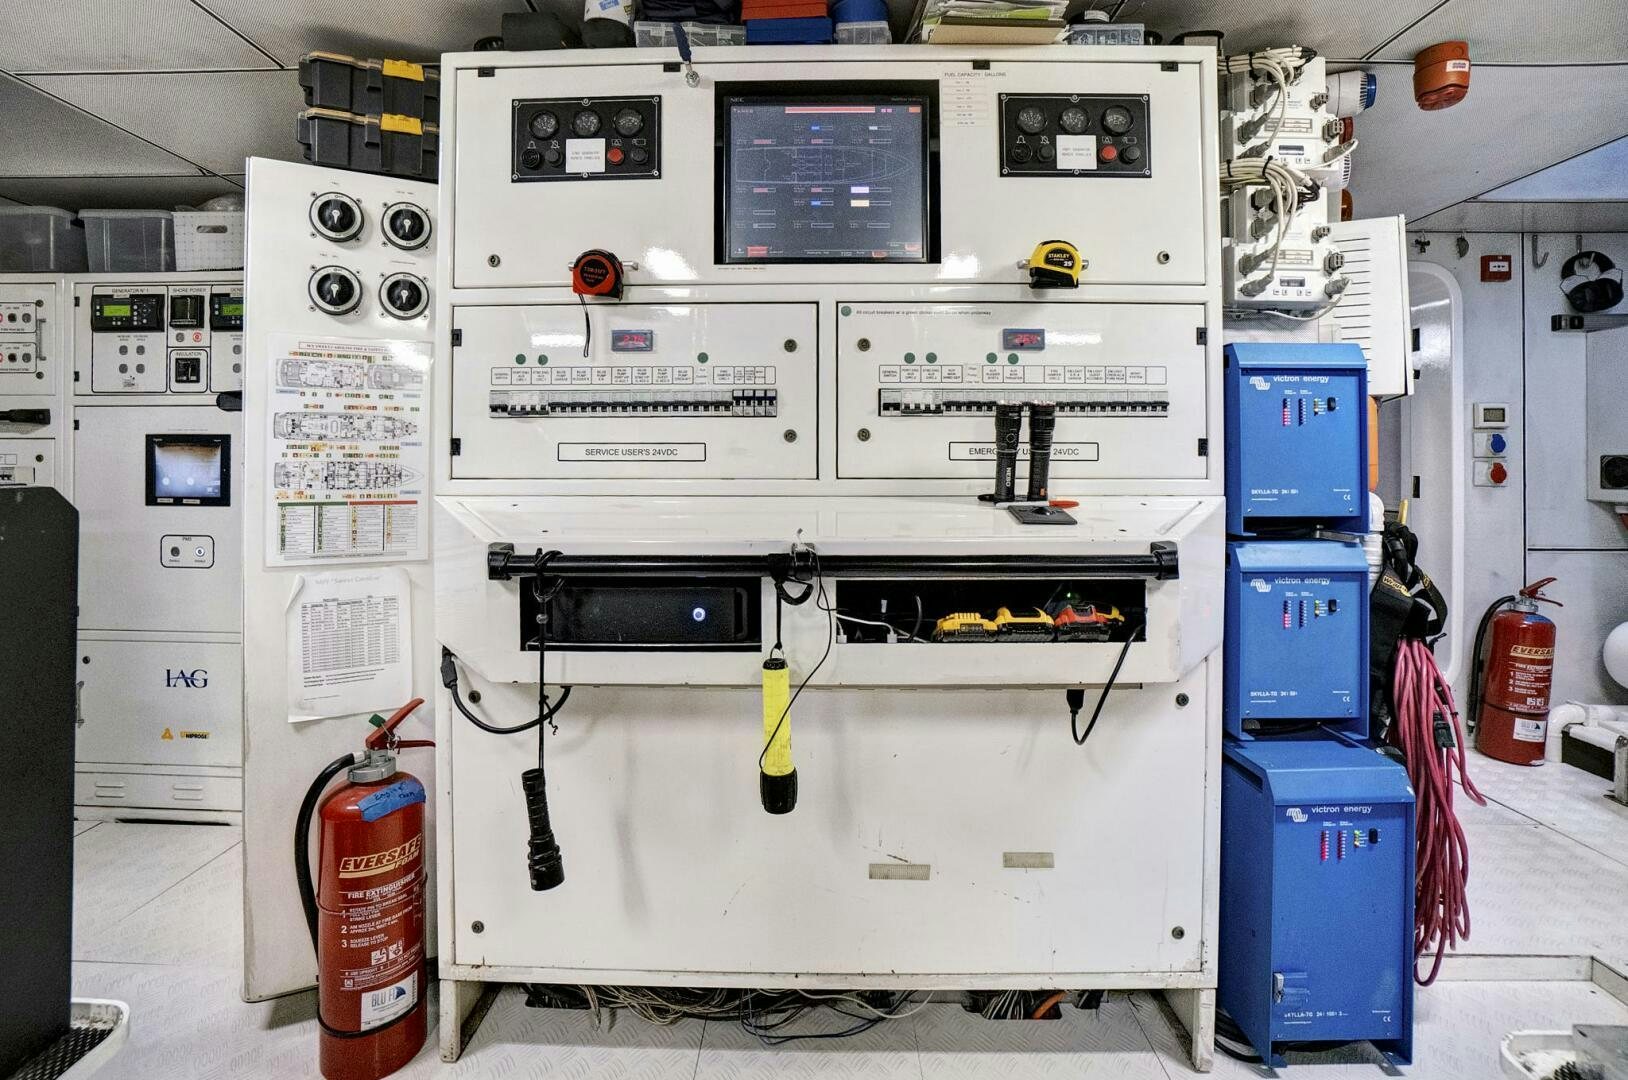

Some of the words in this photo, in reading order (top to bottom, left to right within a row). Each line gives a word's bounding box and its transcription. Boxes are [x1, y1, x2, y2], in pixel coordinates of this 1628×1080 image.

[1303, 376, 1329, 384] energy
[585, 448, 619, 456] SERVICE
[622, 448, 650, 456] USER'S
[652, 448, 678, 456] 24VDC
[1053, 448, 1079, 456] 24VDC
[1304, 577, 1330, 585] energy
[165, 669, 208, 688] IAG
[1311, 805, 1340, 813] victron
[1343, 805, 1372, 814] energy
[339, 833, 423, 872] EVERSAFE
[347, 890, 365, 899] FIRE
[366, 872, 415, 897] EXTINGUISHER
[341, 909, 346, 919] 1
[341, 925, 348, 934] 2
[341, 939, 348, 948] 3
[371, 991, 387, 1008] BLU
